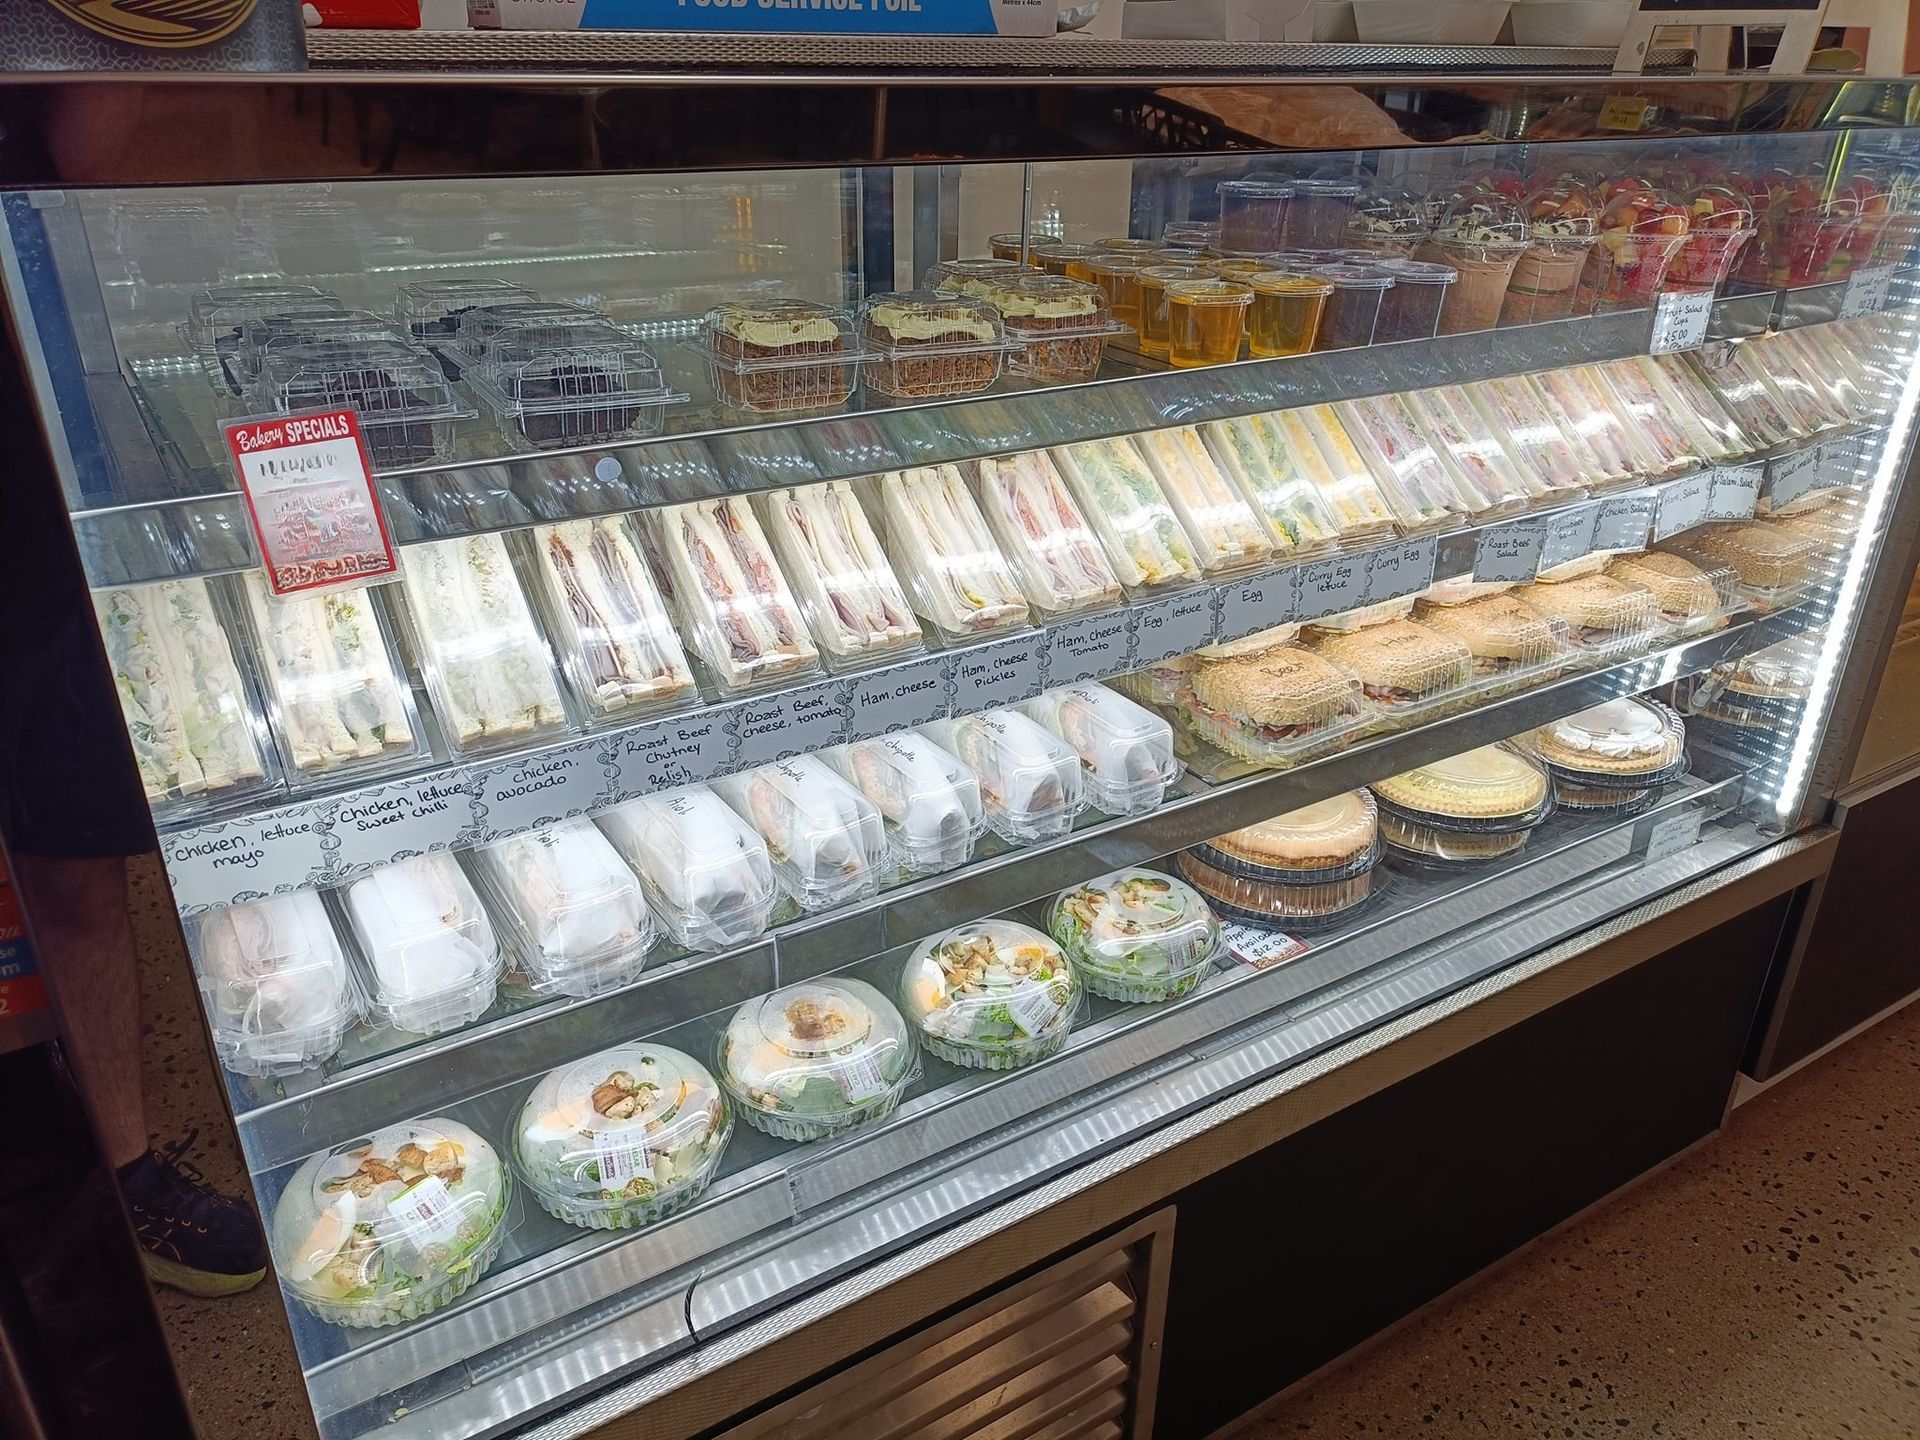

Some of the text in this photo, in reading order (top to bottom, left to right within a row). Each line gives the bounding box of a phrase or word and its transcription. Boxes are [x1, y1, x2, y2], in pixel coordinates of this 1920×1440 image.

[236, 414, 350, 452] Bakery SPECIALS
[1488, 537, 1531, 549] Roast Beef
[1376, 549, 1420, 571] Curry Egg
[1496, 549, 1518, 559] Salad
[1308, 566, 1353, 586] Curry Egg
[1316, 579, 1348, 593] lettuce
[1241, 588, 1264, 603] Egg
[1172, 603, 1202, 619] lettuce
[1069, 642, 1110, 658] Tomato
[974, 669, 1017, 689] Pickles
[745, 695, 829, 726] Roast Beef,
[796, 706, 843, 725] tomato
[625, 723, 713, 756] Roast Beef
[645, 742, 702, 765] Chutney
[647, 764, 692, 787] Relish
[663, 761, 677, 770] or
[496, 775, 567, 802] avocado
[340, 782, 463, 824] Chicken, lettuce
[411, 799, 449, 818] chilli
[260, 822, 312, 842] lettuce
[212, 849, 265, 869] mayo
[1225, 926, 1252, 943] Apple
[1252, 937, 1288, 957] $12.00
